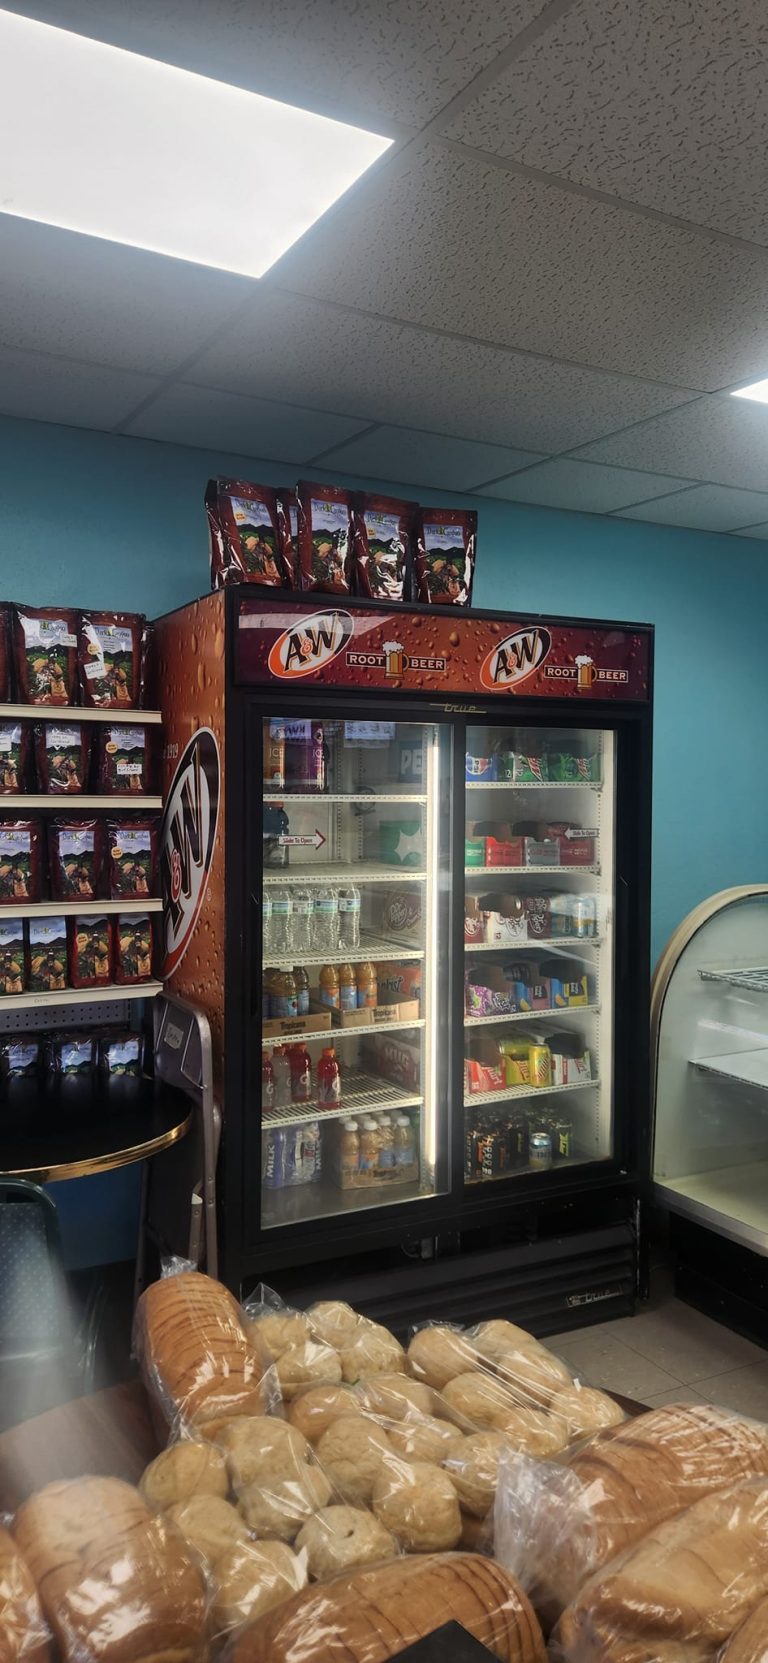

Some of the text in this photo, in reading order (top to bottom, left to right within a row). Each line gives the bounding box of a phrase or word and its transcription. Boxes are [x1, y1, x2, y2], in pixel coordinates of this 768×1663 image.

[284, 611, 340, 672] A&W
[493, 628, 540, 684] A&W
[349, 654, 444, 669] ROOT BEER
[547, 668, 626, 680] ROOT BEER
[266, 1145, 275, 1178] MILK
